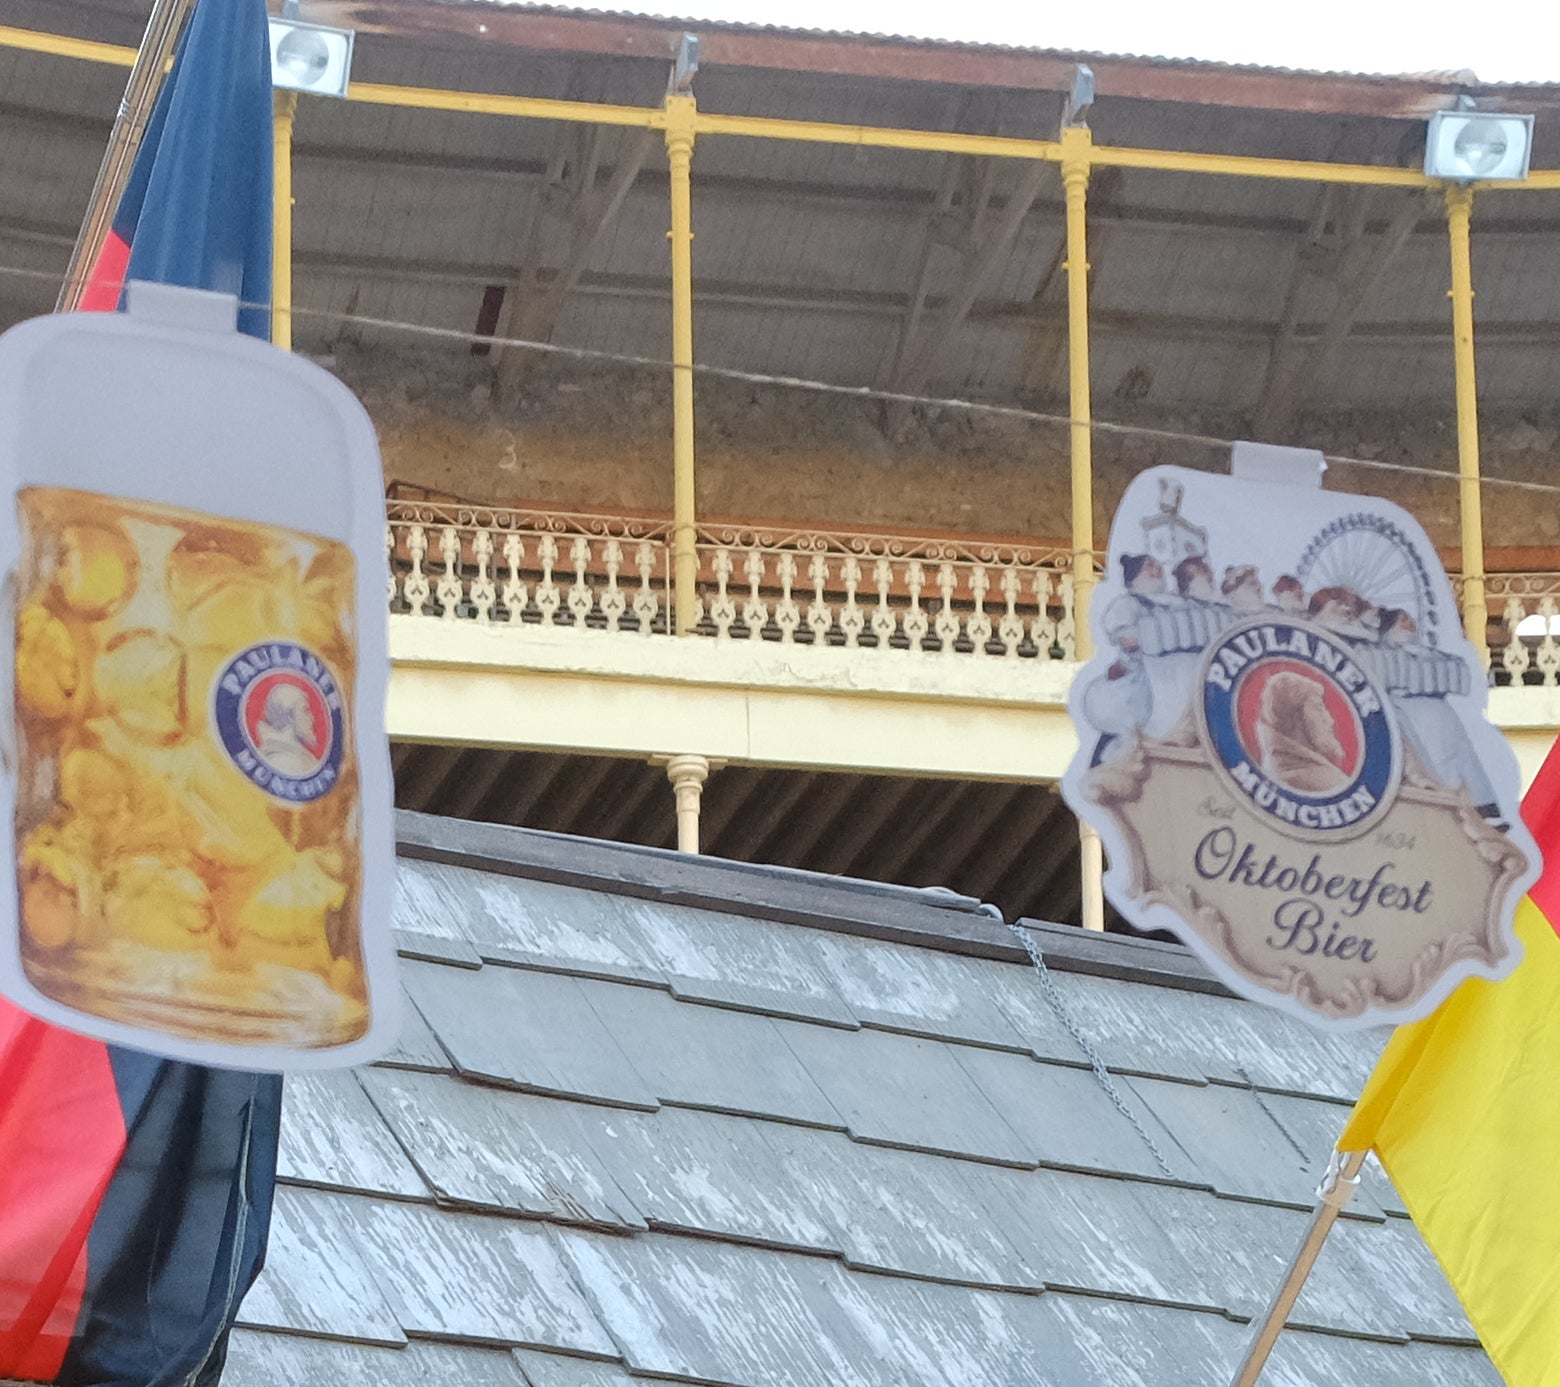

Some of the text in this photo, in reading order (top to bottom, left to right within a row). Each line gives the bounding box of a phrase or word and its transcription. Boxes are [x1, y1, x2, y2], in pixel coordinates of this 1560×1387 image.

[1203, 622, 1383, 719] PAULANER
[1194, 826, 1434, 918] Oktoberfest
[1266, 897, 1378, 964] Bier
